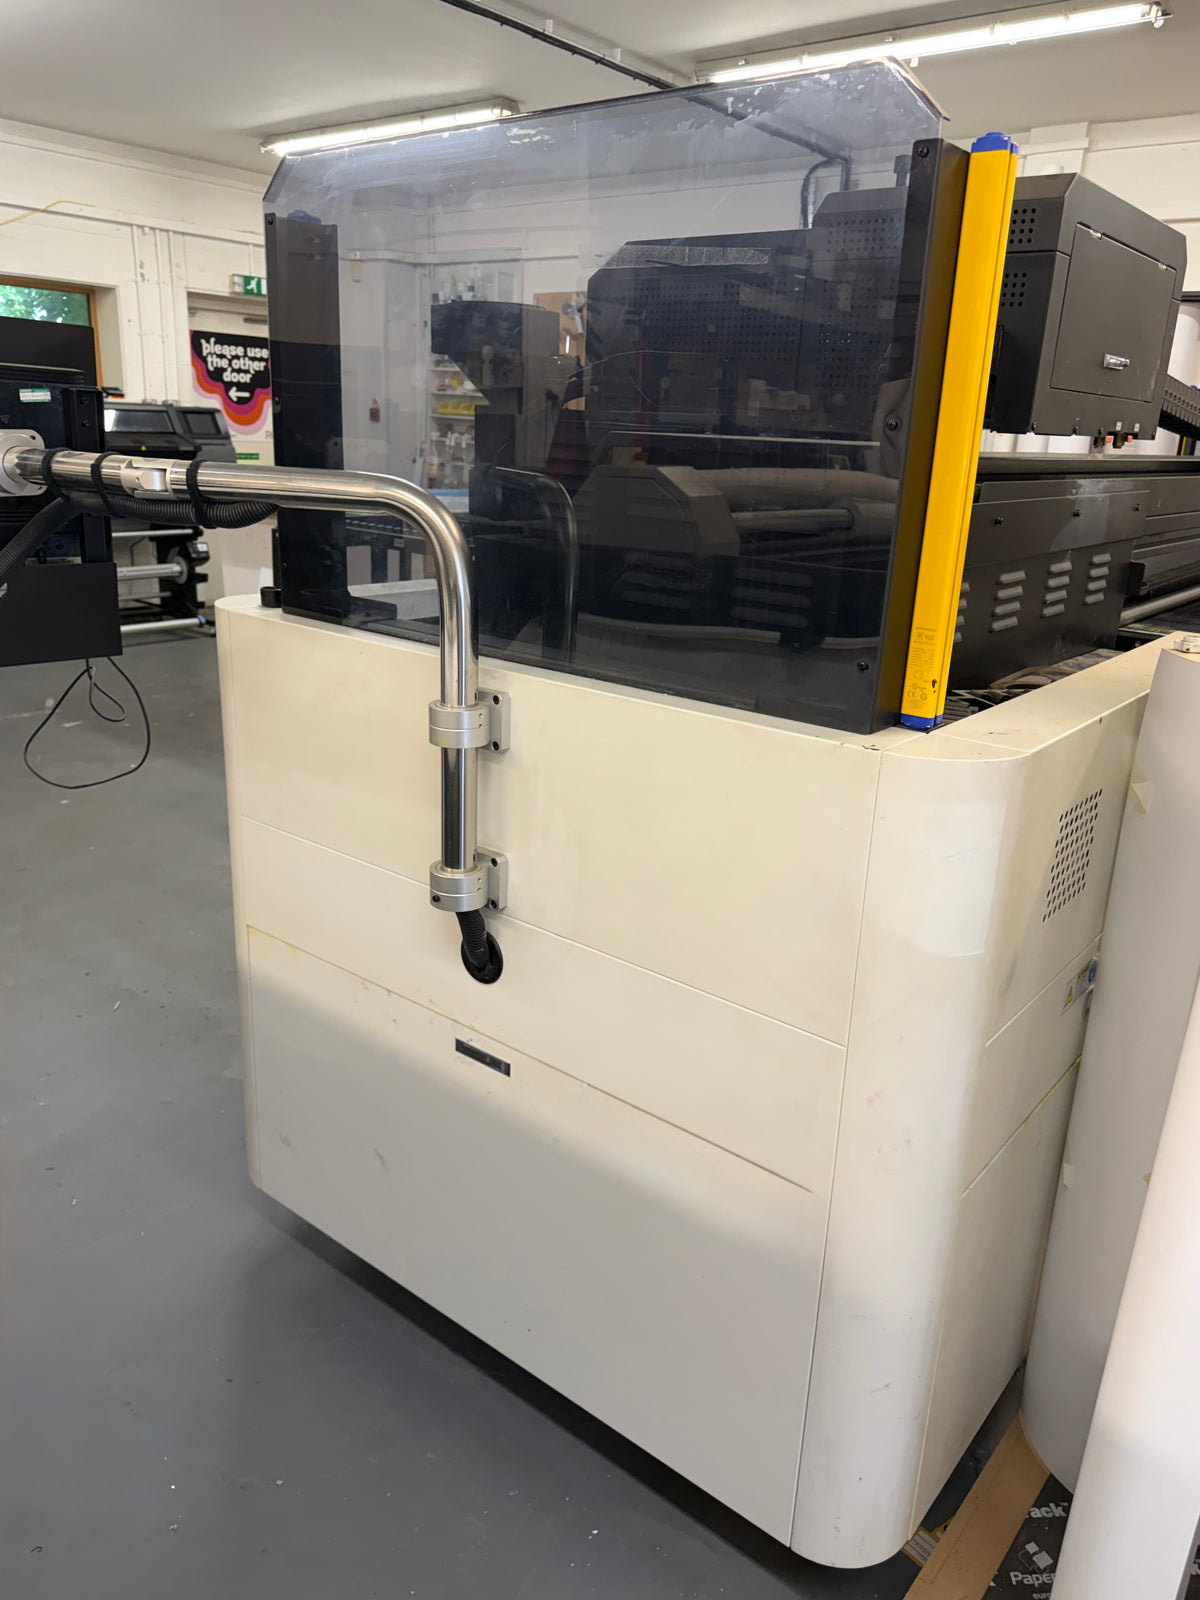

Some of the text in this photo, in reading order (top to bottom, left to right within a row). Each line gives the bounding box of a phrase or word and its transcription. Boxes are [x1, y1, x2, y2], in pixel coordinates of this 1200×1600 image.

[200, 337, 269, 359] please use
[207, 353, 266, 374] the other
[222, 367, 253, 383] door
[1026, 1503, 1067, 1518] ack
